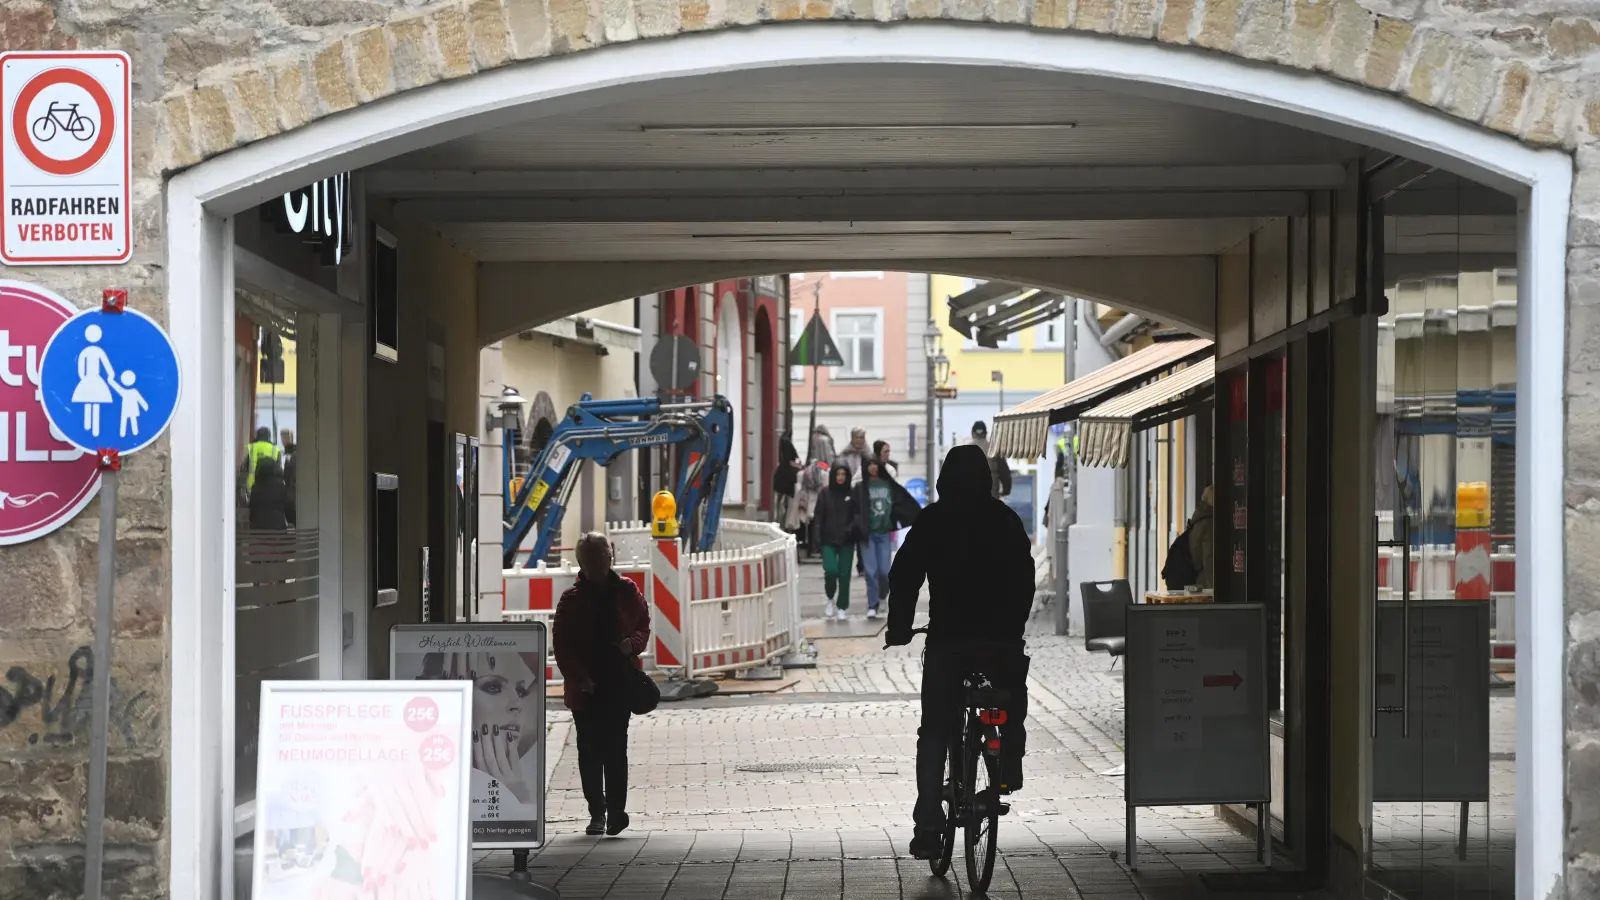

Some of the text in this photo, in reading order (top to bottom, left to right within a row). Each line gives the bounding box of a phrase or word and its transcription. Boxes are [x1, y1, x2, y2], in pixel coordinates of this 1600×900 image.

[11, 197, 119, 216] RADFAHREN
[17, 222, 113, 242] VERBOTEN
[418, 632, 518, 652] Herzlich Willkommen
[280, 704, 393, 719] FUSSPFLEGE
[407, 706, 436, 722] 25€
[278, 747, 410, 763] NEUMODELLAGE
[423, 747, 452, 762] 25€
